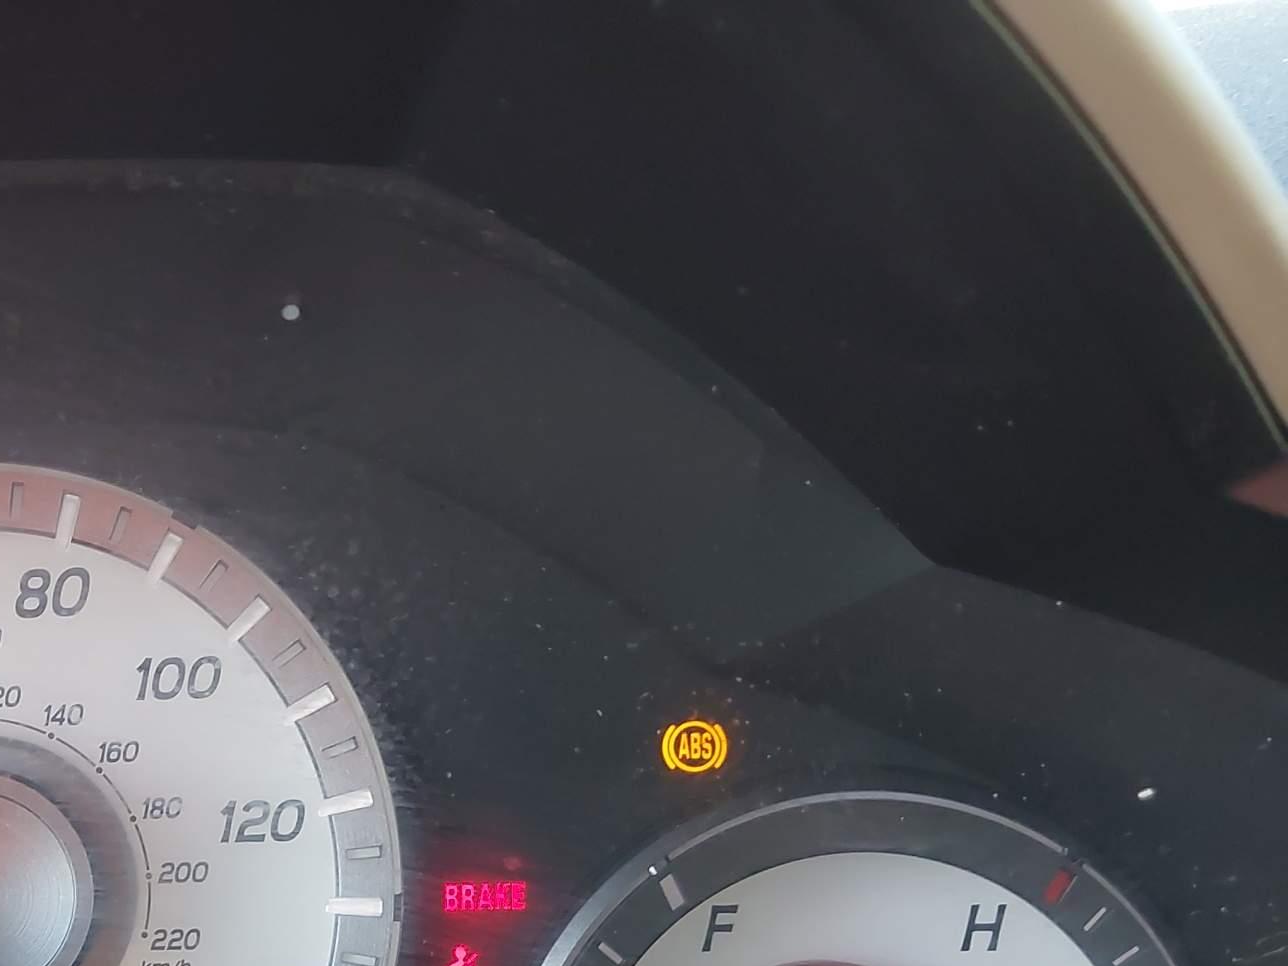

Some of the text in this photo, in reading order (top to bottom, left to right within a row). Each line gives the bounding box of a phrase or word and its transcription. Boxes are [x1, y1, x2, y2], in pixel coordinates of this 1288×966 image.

[14, 567, 91, 619] 80
[136, 656, 222, 702] 100
[42, 702, 85, 728] 140
[98, 740, 139, 765] 160
[677, 733, 714, 760] ABS
[141, 796, 183, 821] 180
[219, 799, 306, 844] 120
[157, 860, 209, 885] 200
[443, 882, 527, 913] BRAKE
[149, 928, 201, 952] 220
[701, 904, 739, 952] F
[960, 904, 1008, 952] H
